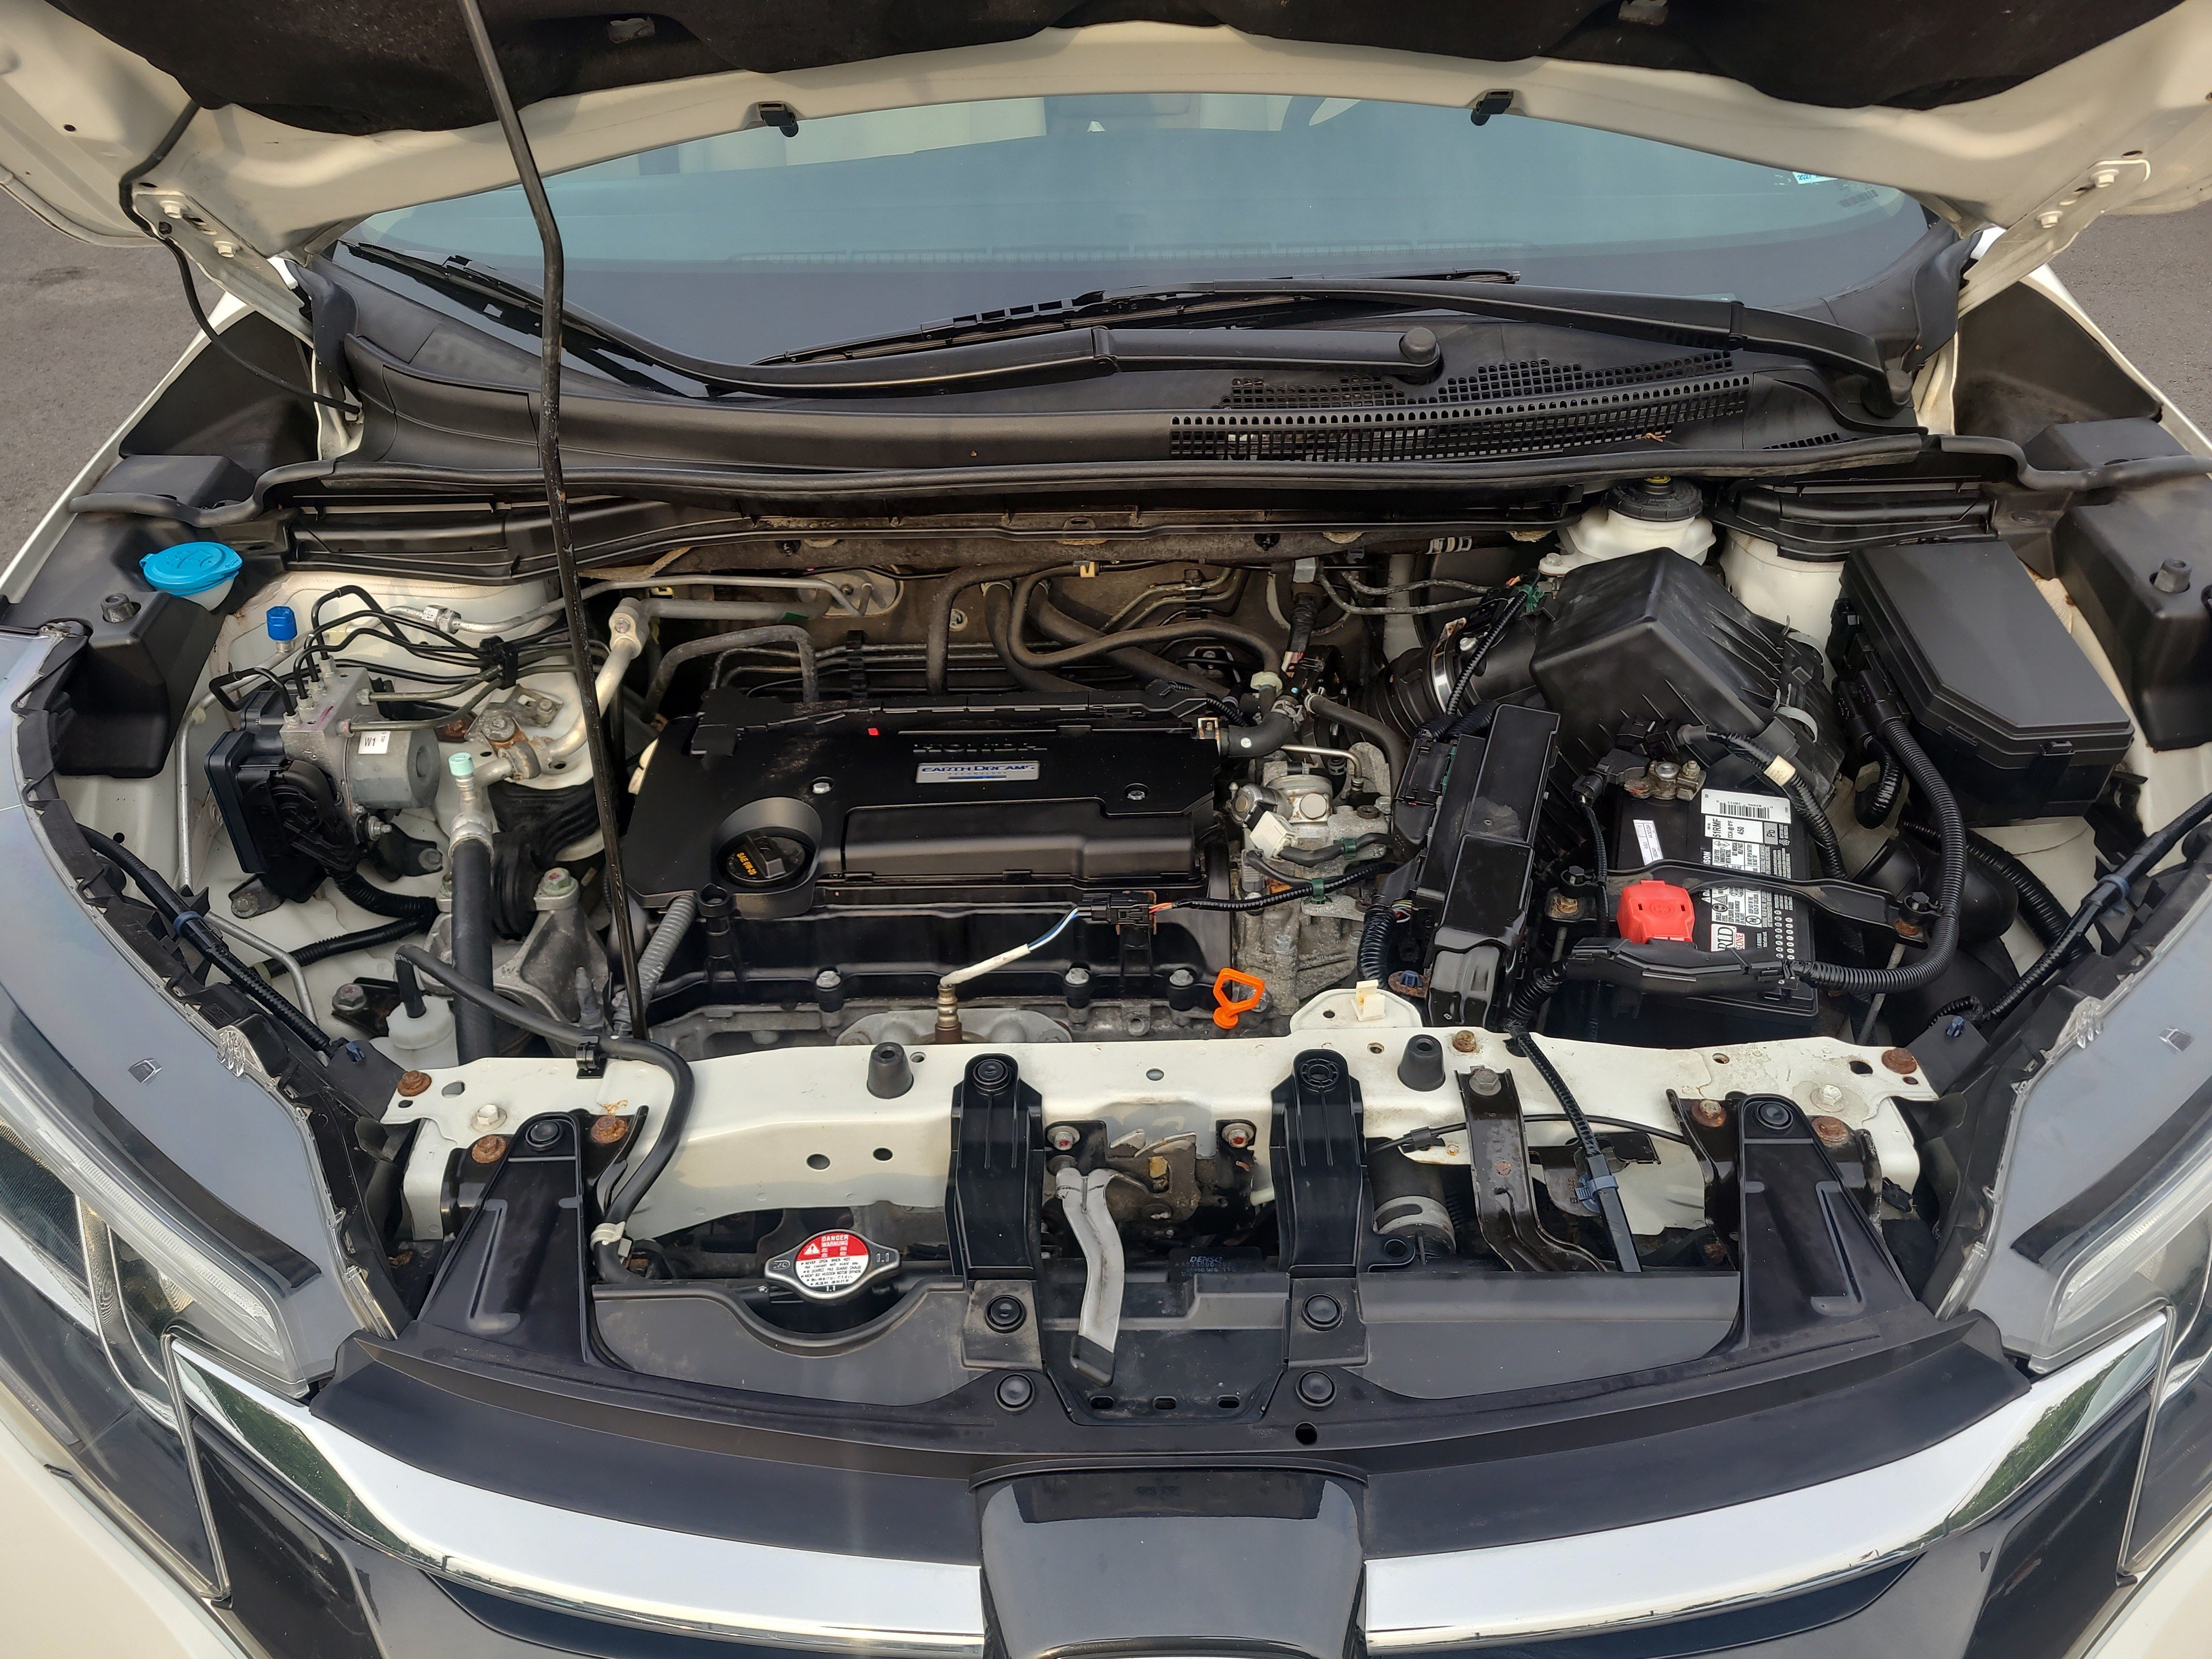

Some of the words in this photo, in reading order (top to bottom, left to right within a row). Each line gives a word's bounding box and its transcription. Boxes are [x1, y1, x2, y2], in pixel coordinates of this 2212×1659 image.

[364, 737, 376, 746] W1
[1712, 818, 1722, 838] 51RMF
[1766, 830, 1775, 838] Pb
[737, 853, 749, 862] SAE
[743, 861, 757, 875] 0W-20
[821, 1234, 849, 1242] DANGER
[876, 1252, 890, 1262] 1.1
